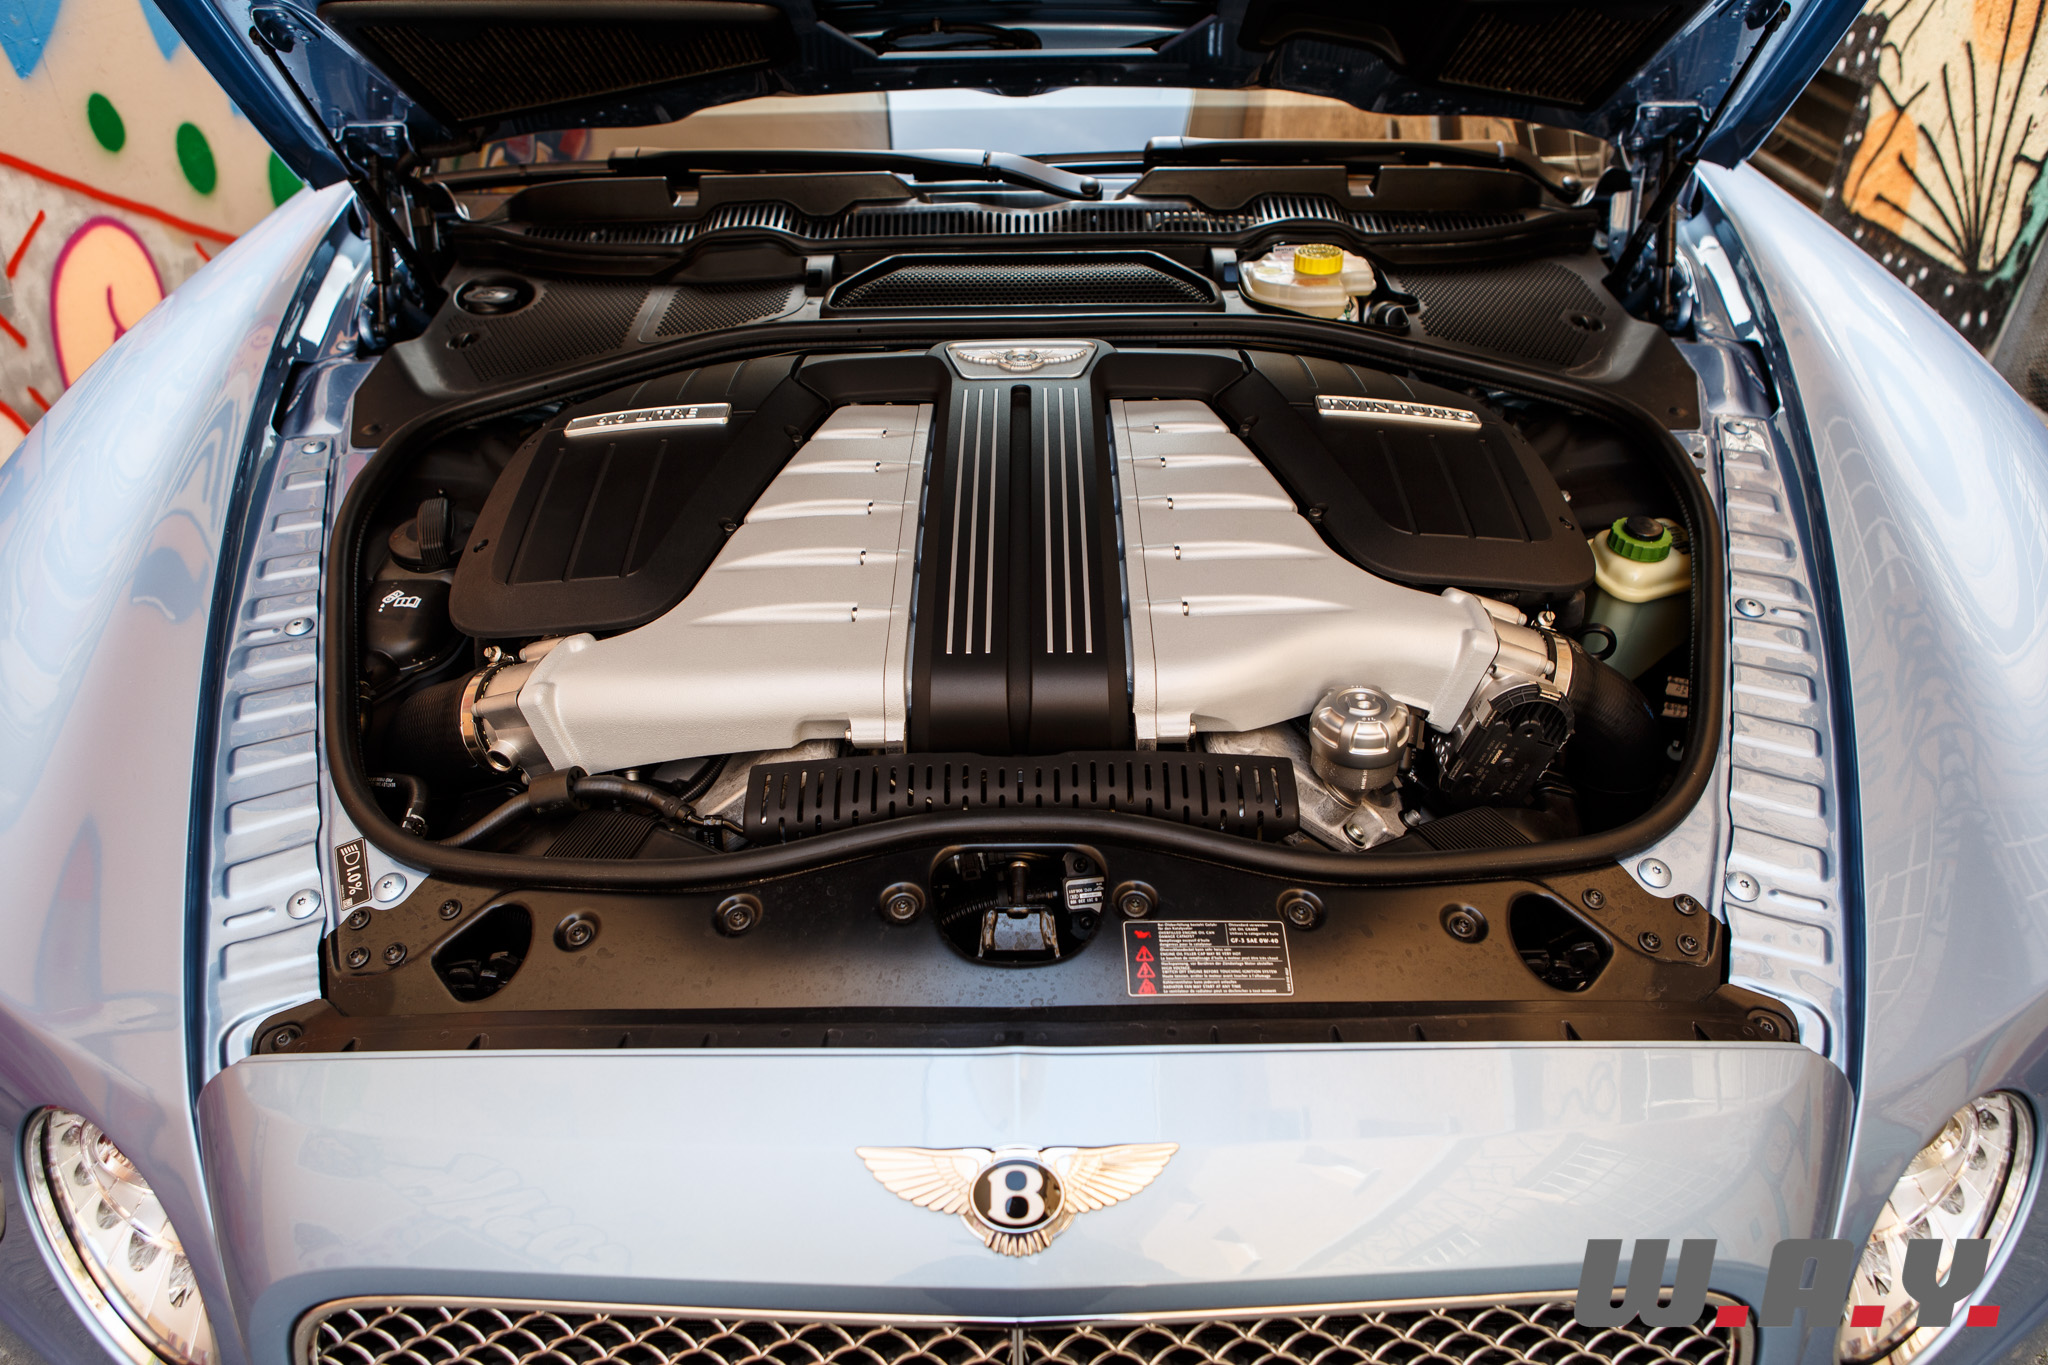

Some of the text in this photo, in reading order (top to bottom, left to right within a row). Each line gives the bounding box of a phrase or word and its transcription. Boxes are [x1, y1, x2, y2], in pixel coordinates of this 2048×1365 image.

[596, 408, 698, 425] 6.0 LITRE
[1324, 398, 1473, 421] TWIN TURBO
[346, 865, 363, 895] 1.0%
[986, 1164, 1045, 1225] B
